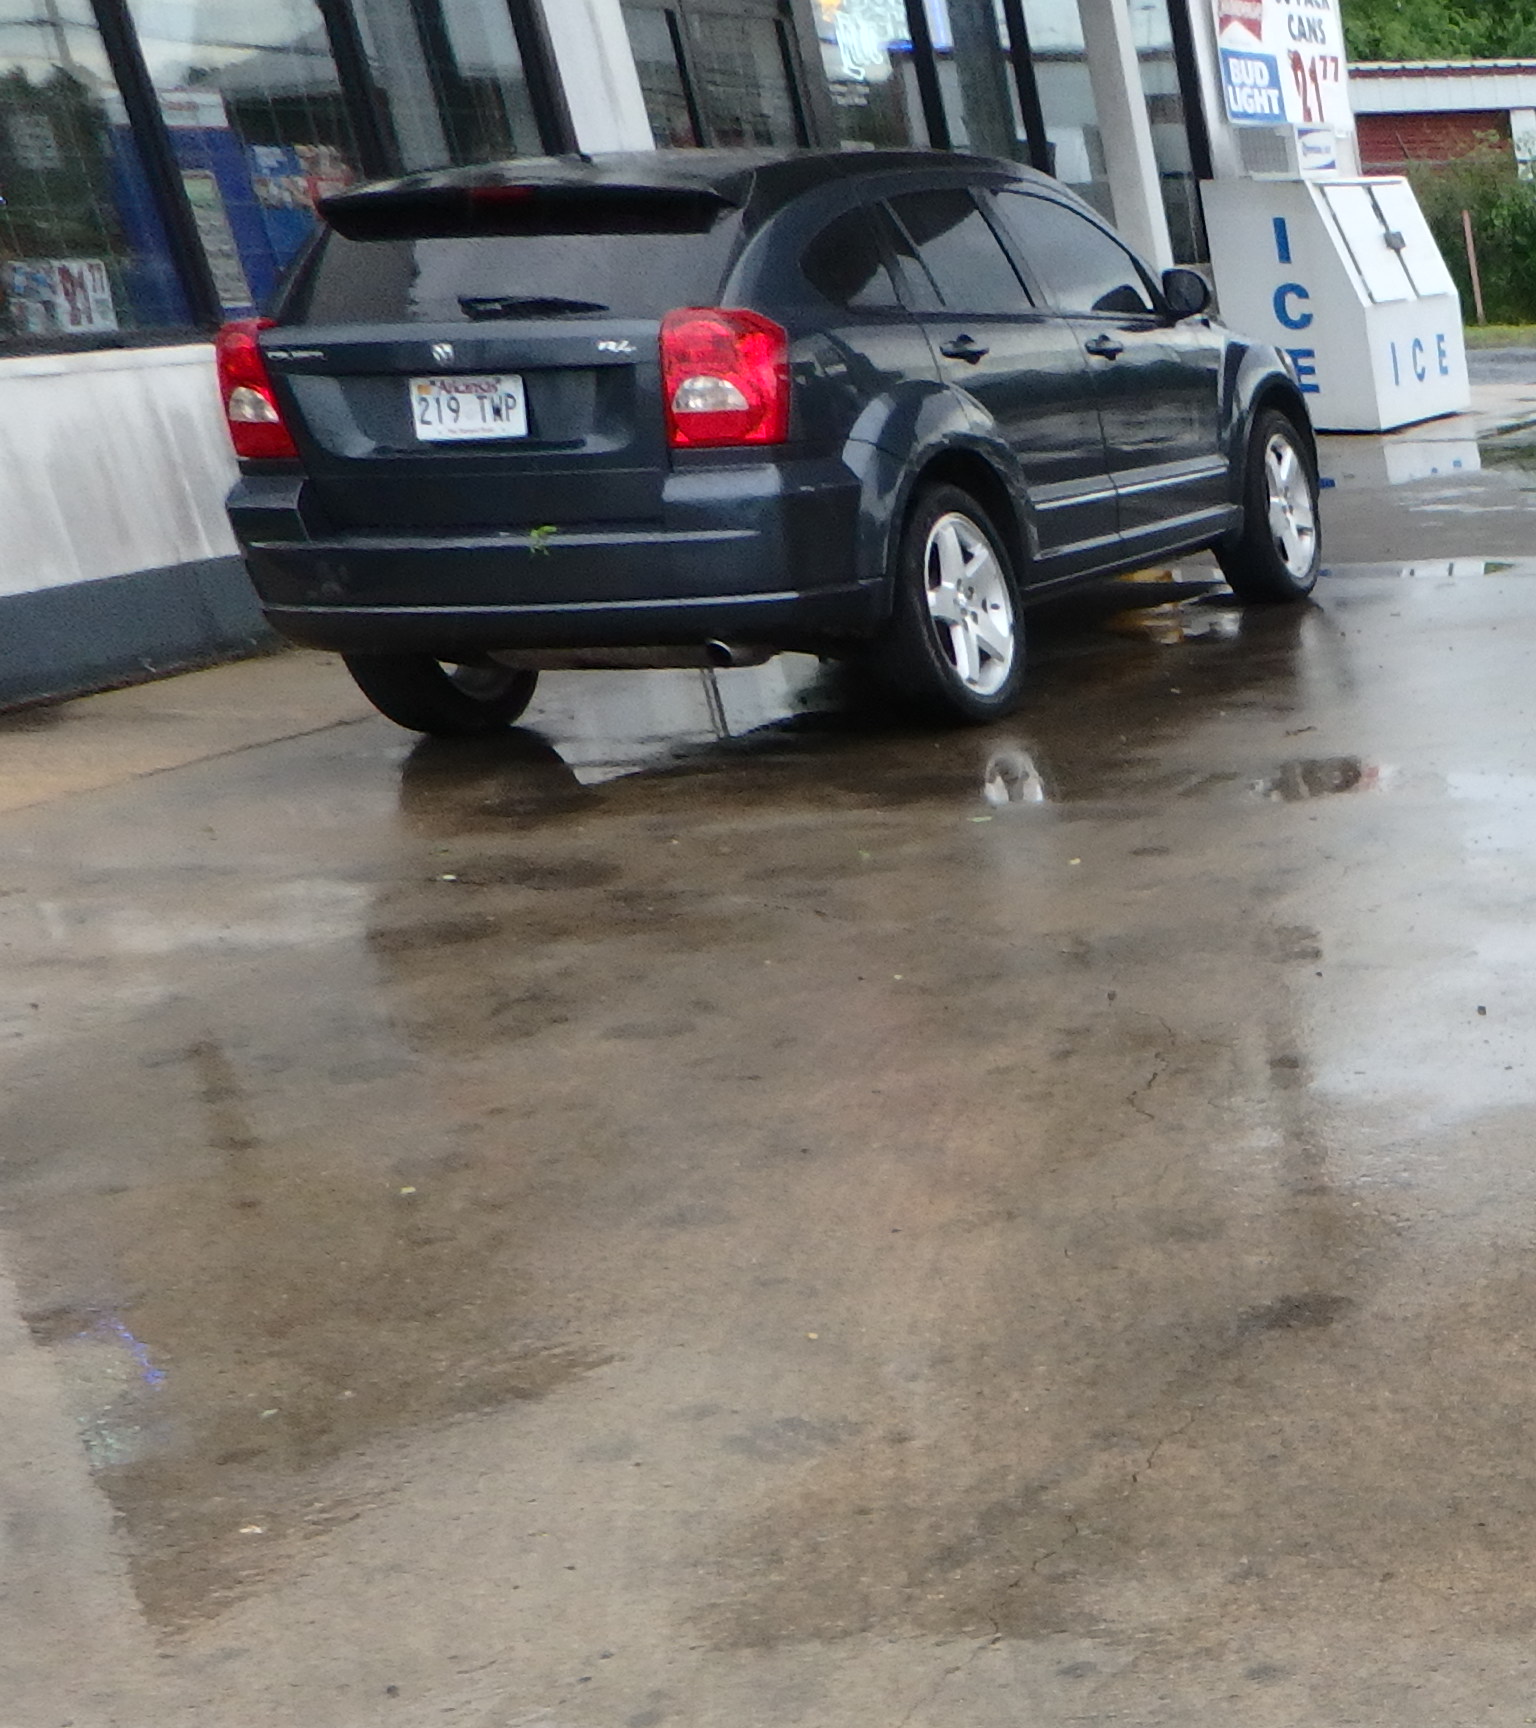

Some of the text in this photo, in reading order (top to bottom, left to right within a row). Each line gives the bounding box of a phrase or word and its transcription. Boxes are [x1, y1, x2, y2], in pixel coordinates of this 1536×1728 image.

[1288, 13, 1327, 45] CANS
[1228, 57, 1270, 88] BUD
[1319, 54, 1339, 83] 77
[1227, 86, 1280, 115] LIGHT
[1273, 217, 1320, 394] ICE
[1390, 333, 1450, 387] ICE
[418, 392, 517, 426] 219 TWP
